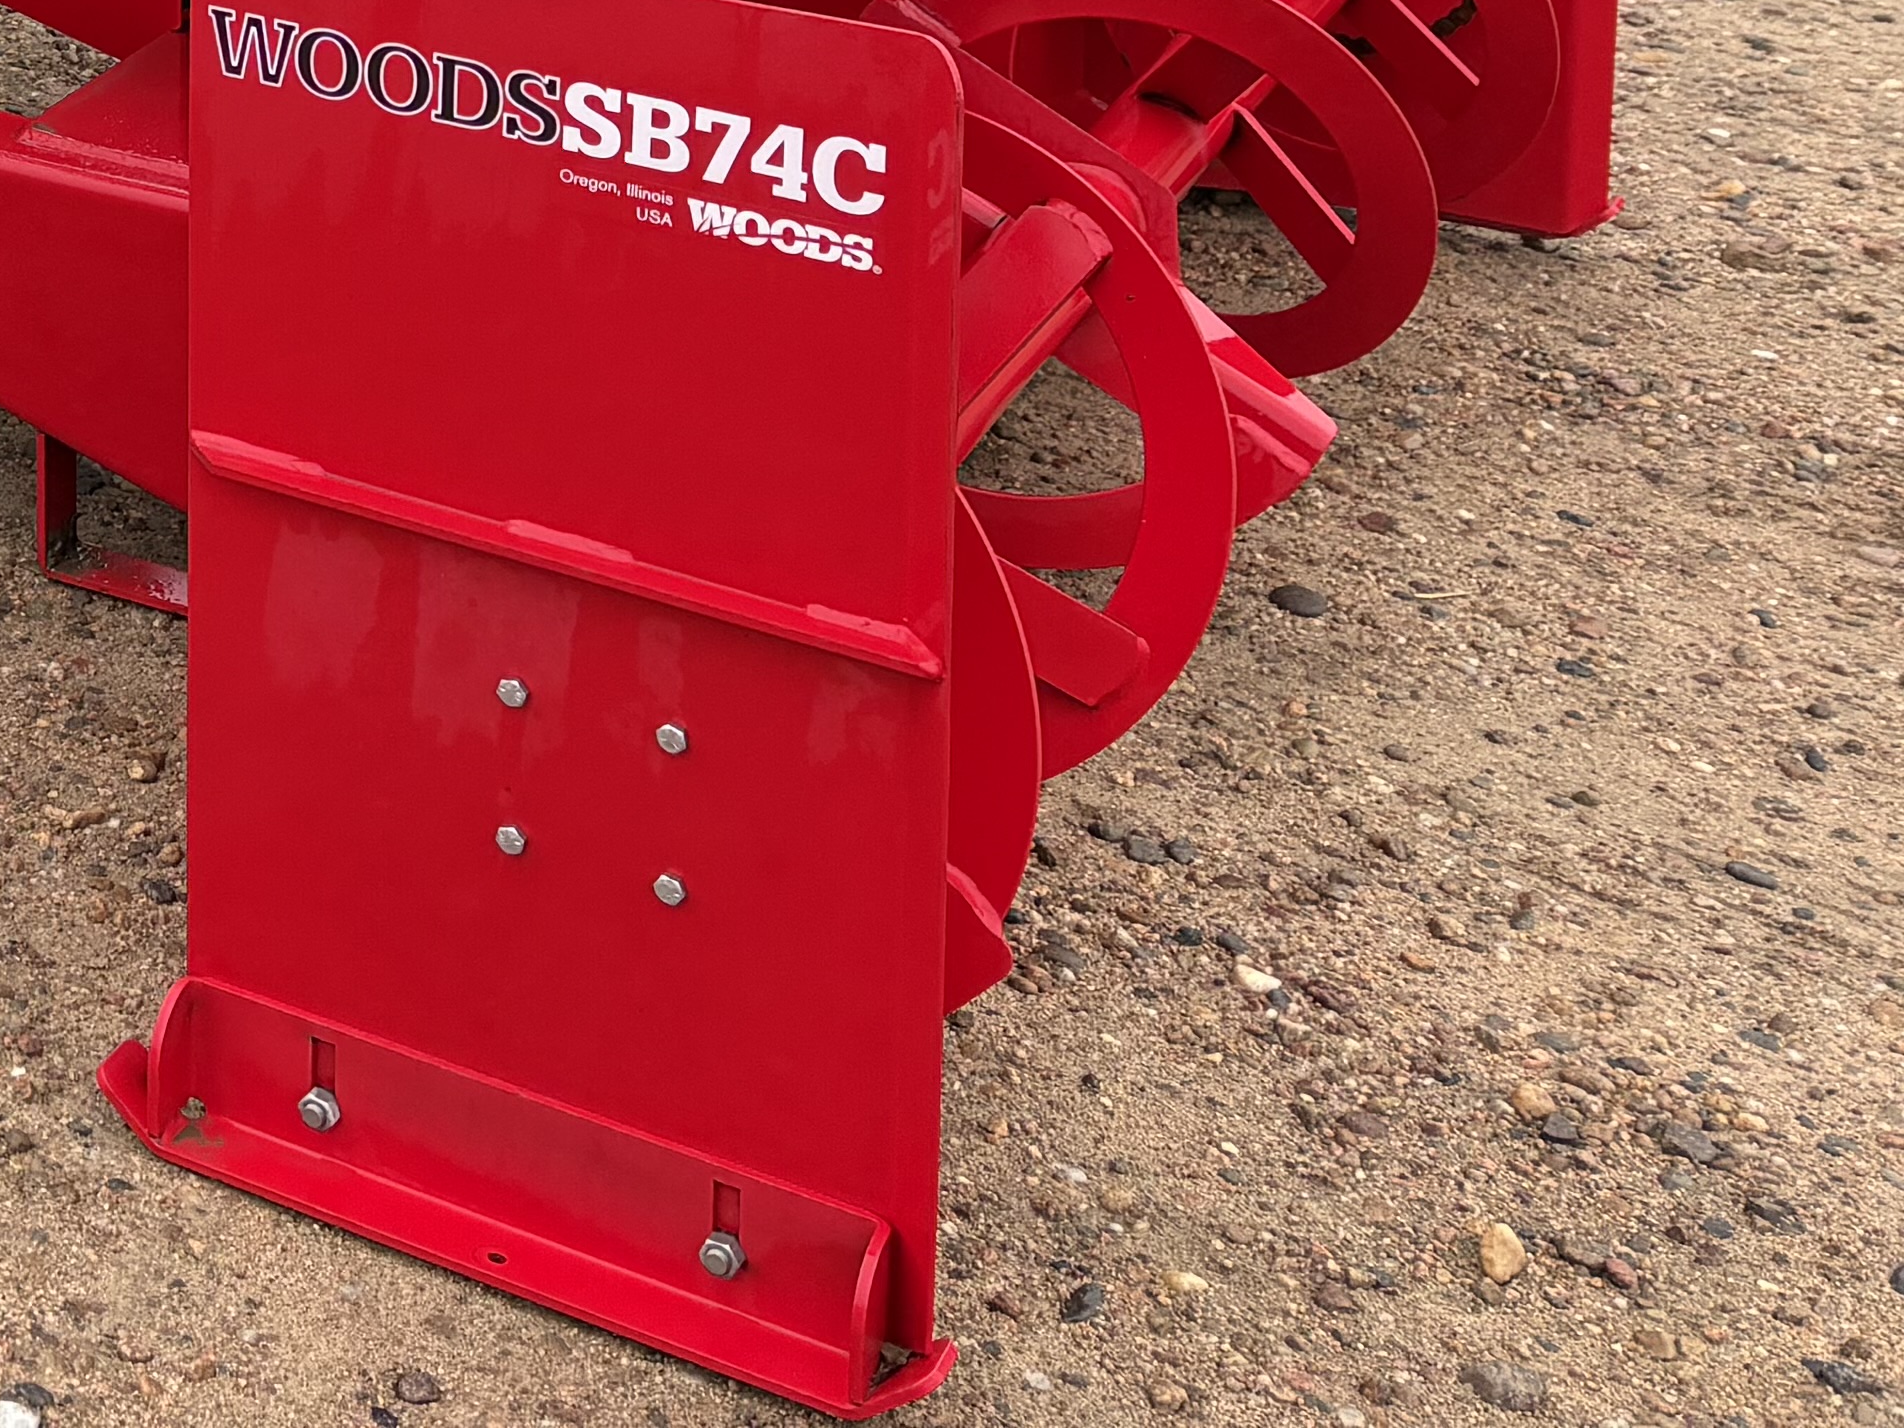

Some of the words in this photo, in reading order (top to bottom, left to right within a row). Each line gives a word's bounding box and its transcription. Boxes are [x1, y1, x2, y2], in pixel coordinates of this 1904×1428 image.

[208, 5, 561, 144] WOODS
[563, 81, 887, 216] SB74C
[559, 168, 622, 196] Oregon,
[625, 182, 674, 206] Illinois
[635, 206, 673, 227] USA
